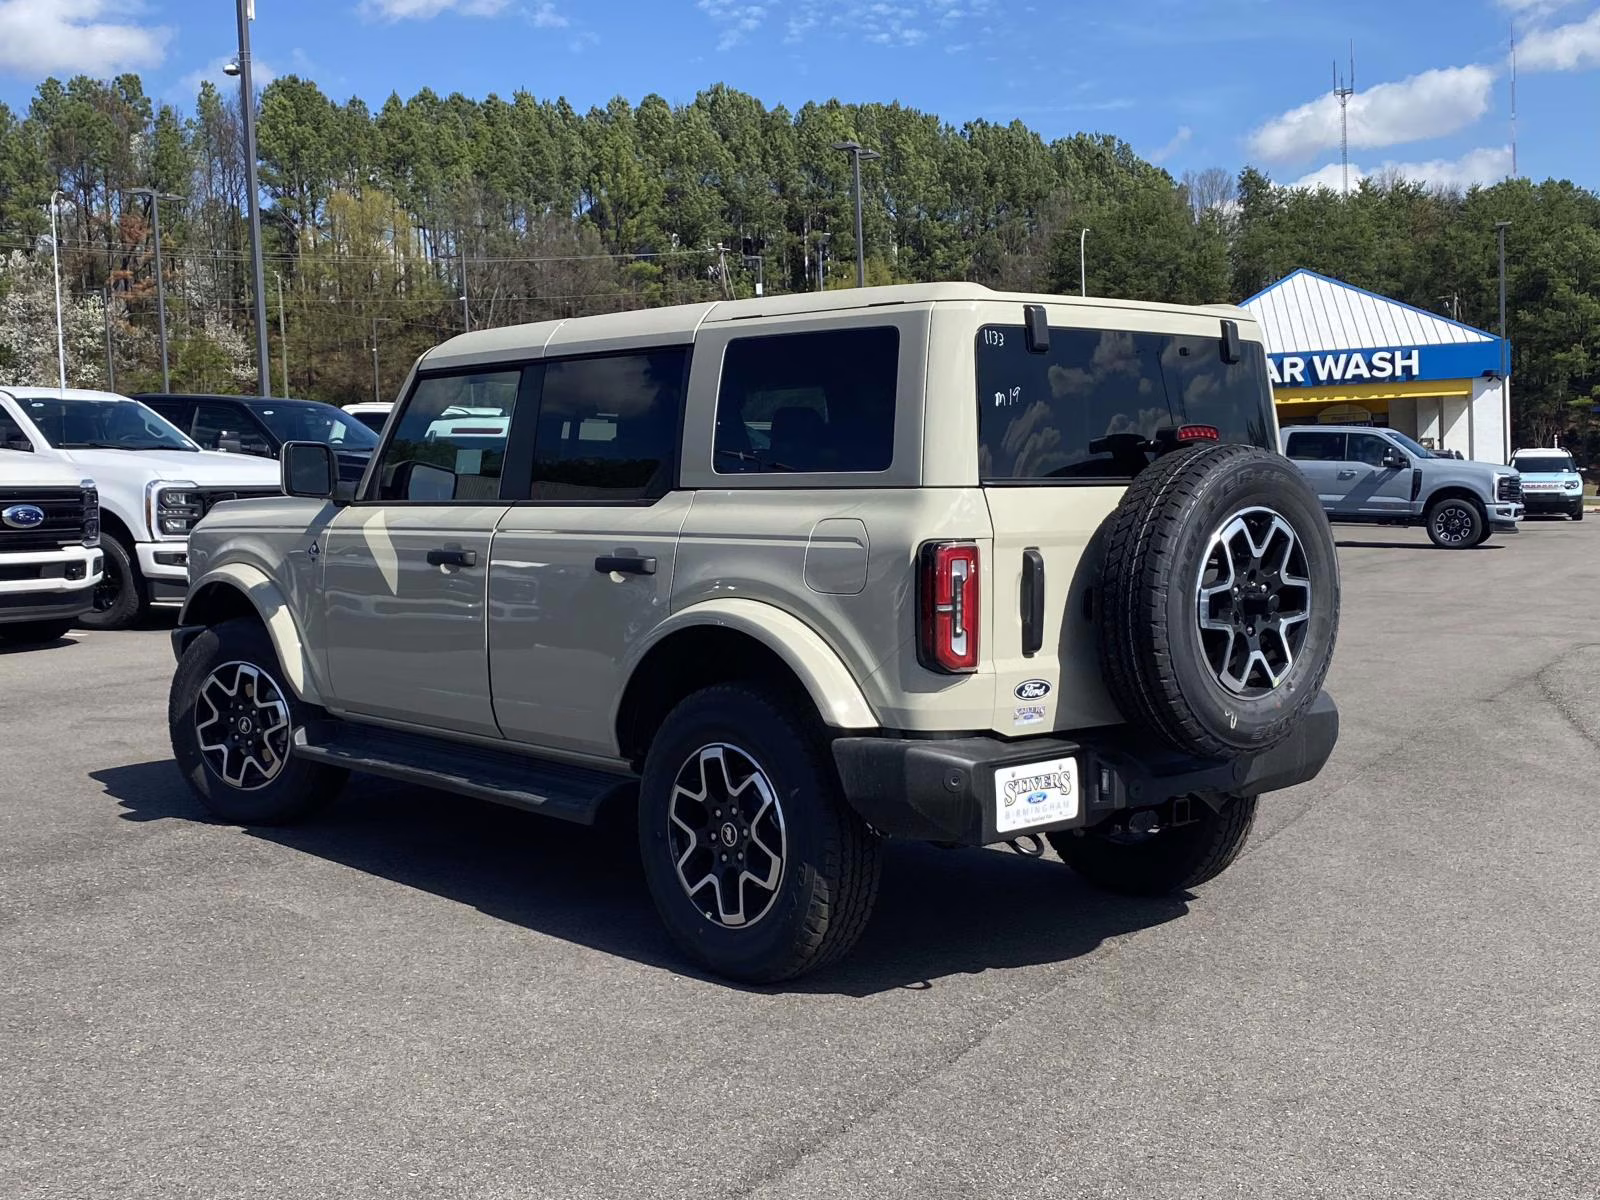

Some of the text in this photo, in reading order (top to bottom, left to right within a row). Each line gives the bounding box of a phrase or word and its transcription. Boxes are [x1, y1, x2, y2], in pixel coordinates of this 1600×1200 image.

[984, 329, 1005, 347] 1133
[1267, 350, 1419, 383] AR WASH
[1020, 682, 1047, 698] Ford
[1004, 770, 1072, 807] STIVERS
